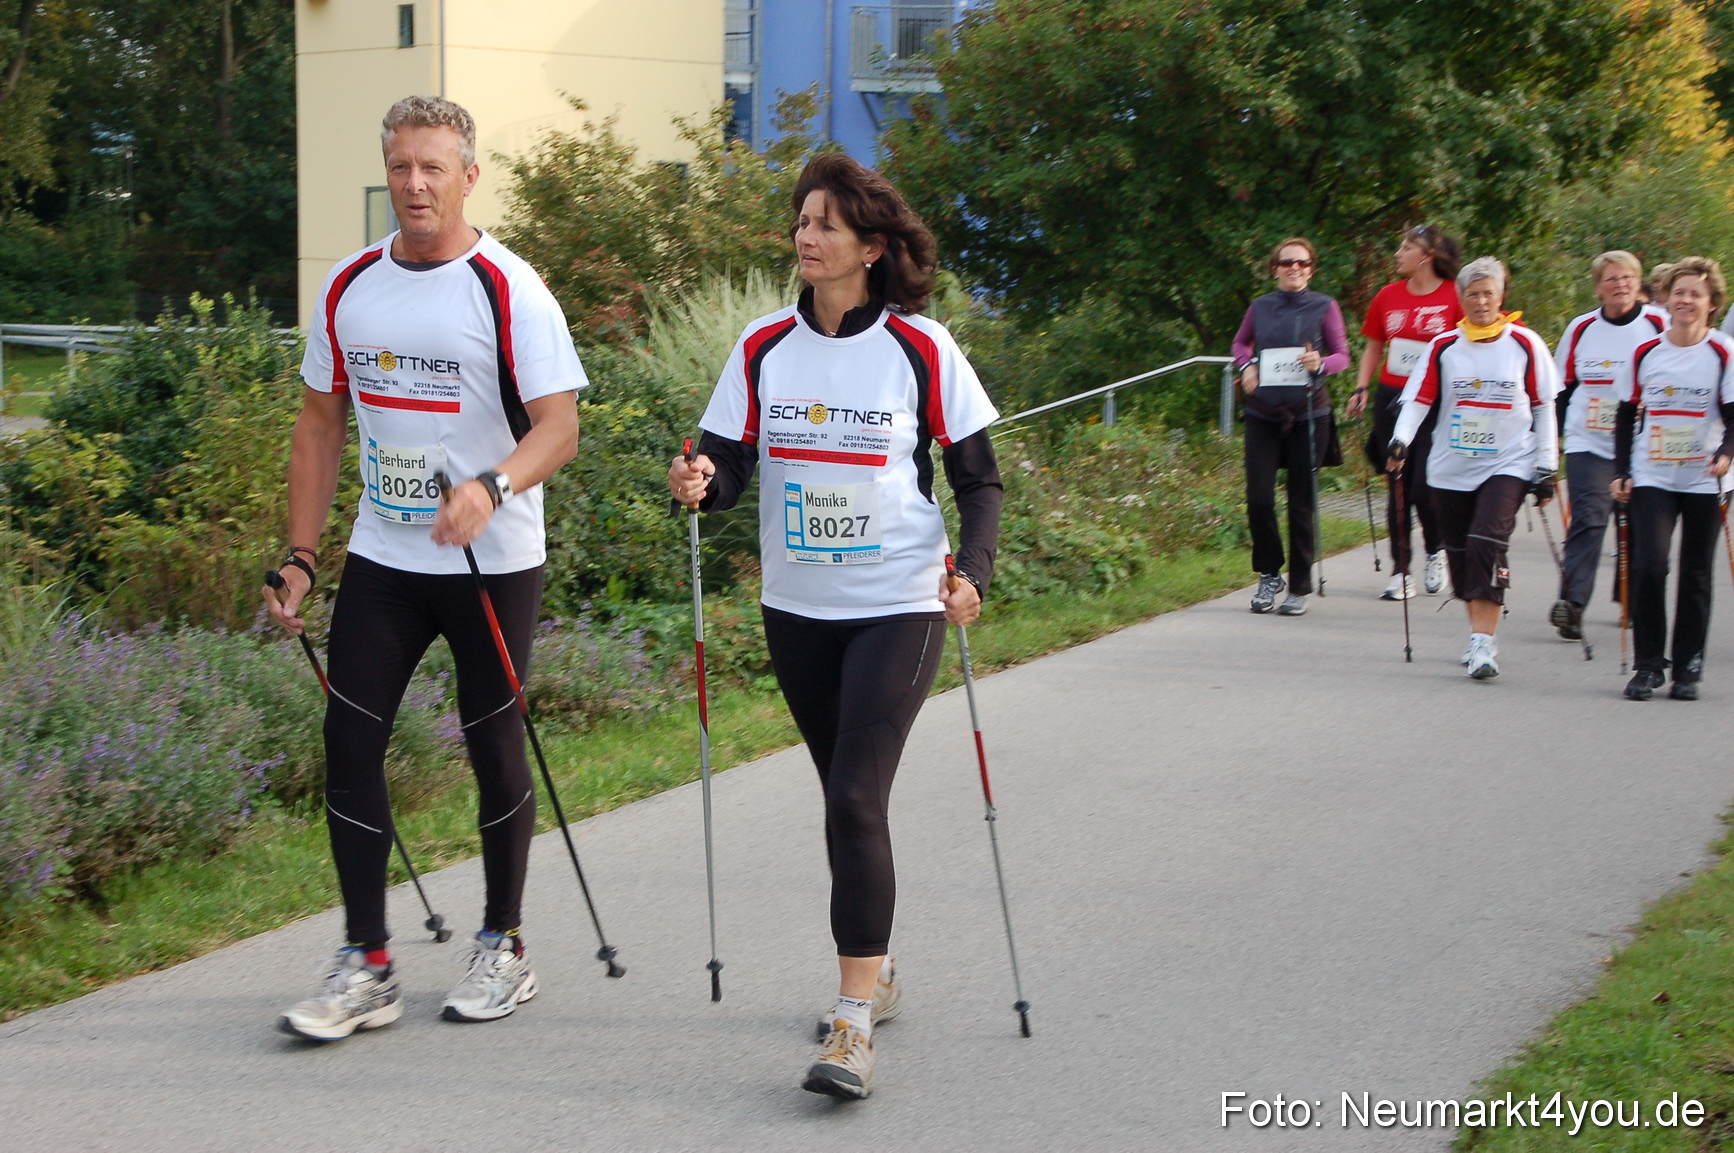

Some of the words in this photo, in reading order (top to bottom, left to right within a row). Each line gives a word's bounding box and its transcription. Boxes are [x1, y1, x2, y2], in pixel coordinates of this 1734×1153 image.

[347, 351, 460, 375] SCHOTTNER
[769, 404, 893, 427] SCHOTTNER
[768, 430, 807, 439] Regensburger
[777, 437, 816, 445] 09181/254801
[1463, 431, 1495, 444] 8028
[379, 449, 426, 469] Gerhard
[382, 474, 440, 499] 8026
[805, 491, 847, 507] Monika
[809, 515, 870, 538] 8027
[843, 550, 881, 559] PFLEIDERER
